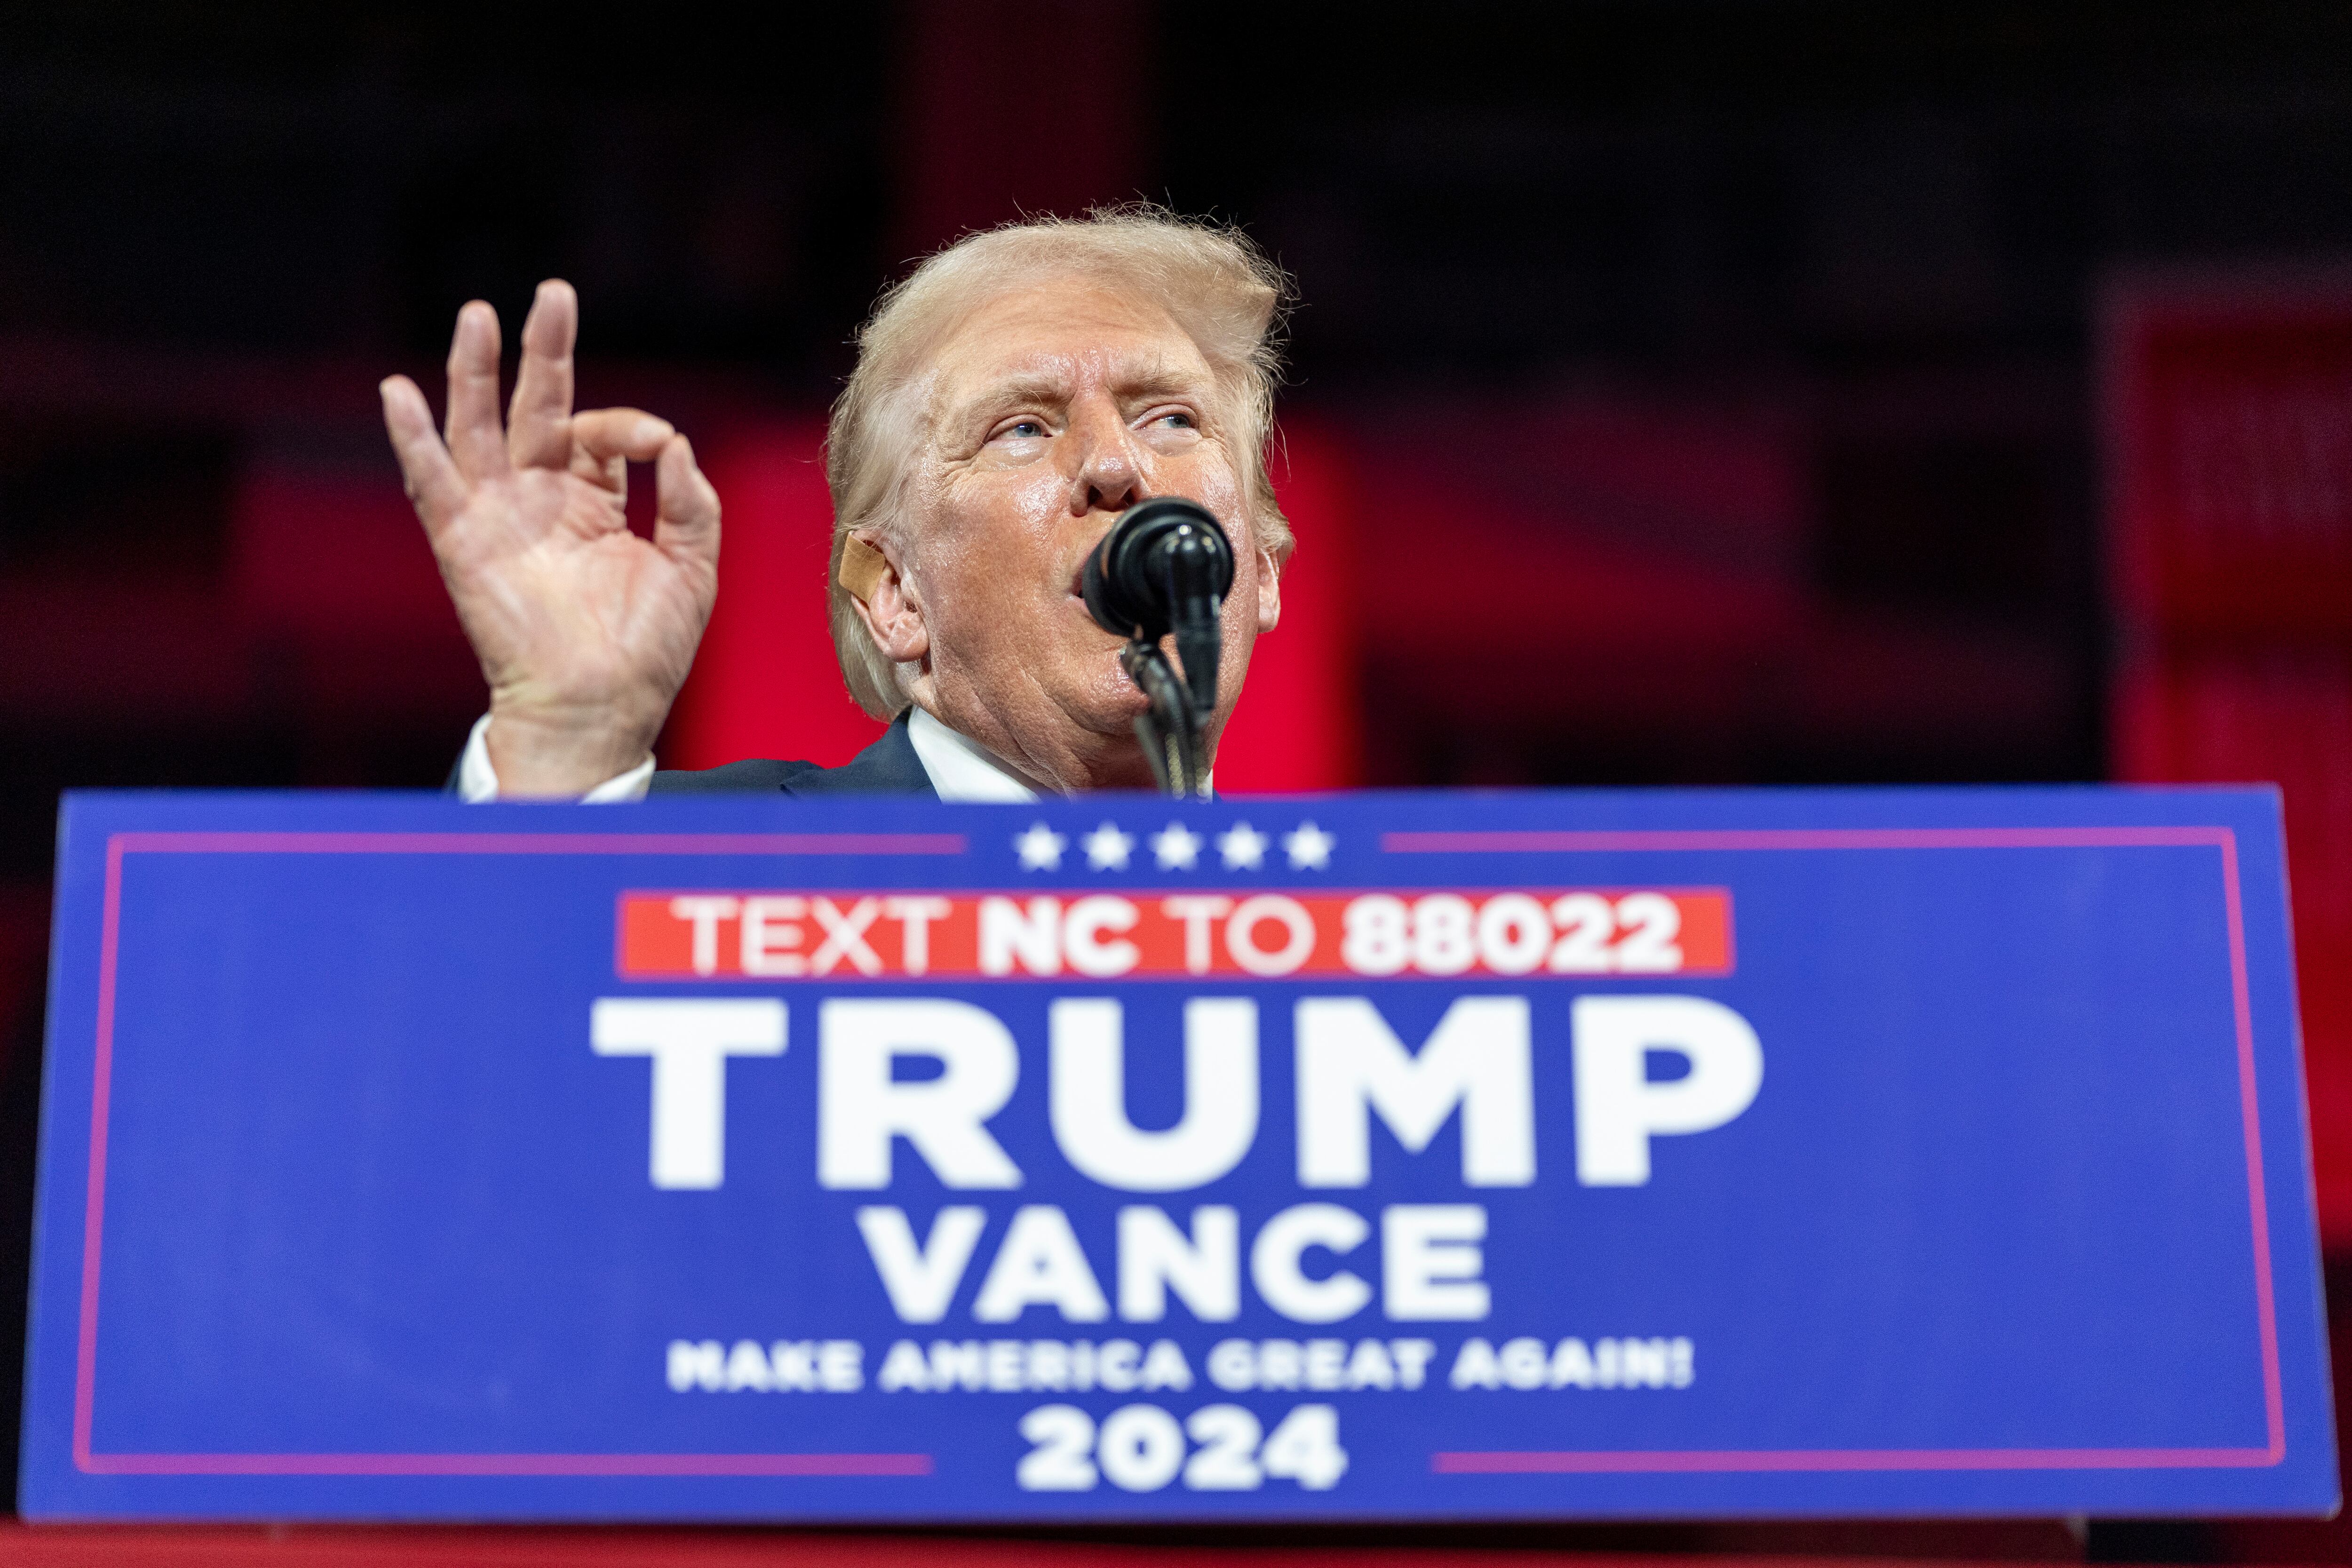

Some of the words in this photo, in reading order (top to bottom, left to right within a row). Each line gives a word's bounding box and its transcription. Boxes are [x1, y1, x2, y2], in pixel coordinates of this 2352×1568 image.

[671, 897, 950, 976] TEXT
[978, 896, 1138, 975] NC
[1164, 895, 1315, 975] TO
[1342, 893, 1682, 974] 88022
[590, 995, 1763, 1191] TRUMP
[858, 1204, 1490, 1322] VANCE
[667, 1341, 861, 1391] MAKE
[880, 1341, 1191, 1391] AMERICA
[1208, 1339, 1433, 1389] GREAT
[1452, 1338, 1692, 1389] AGAIN!
[1018, 1405, 1346, 1490] 2024
